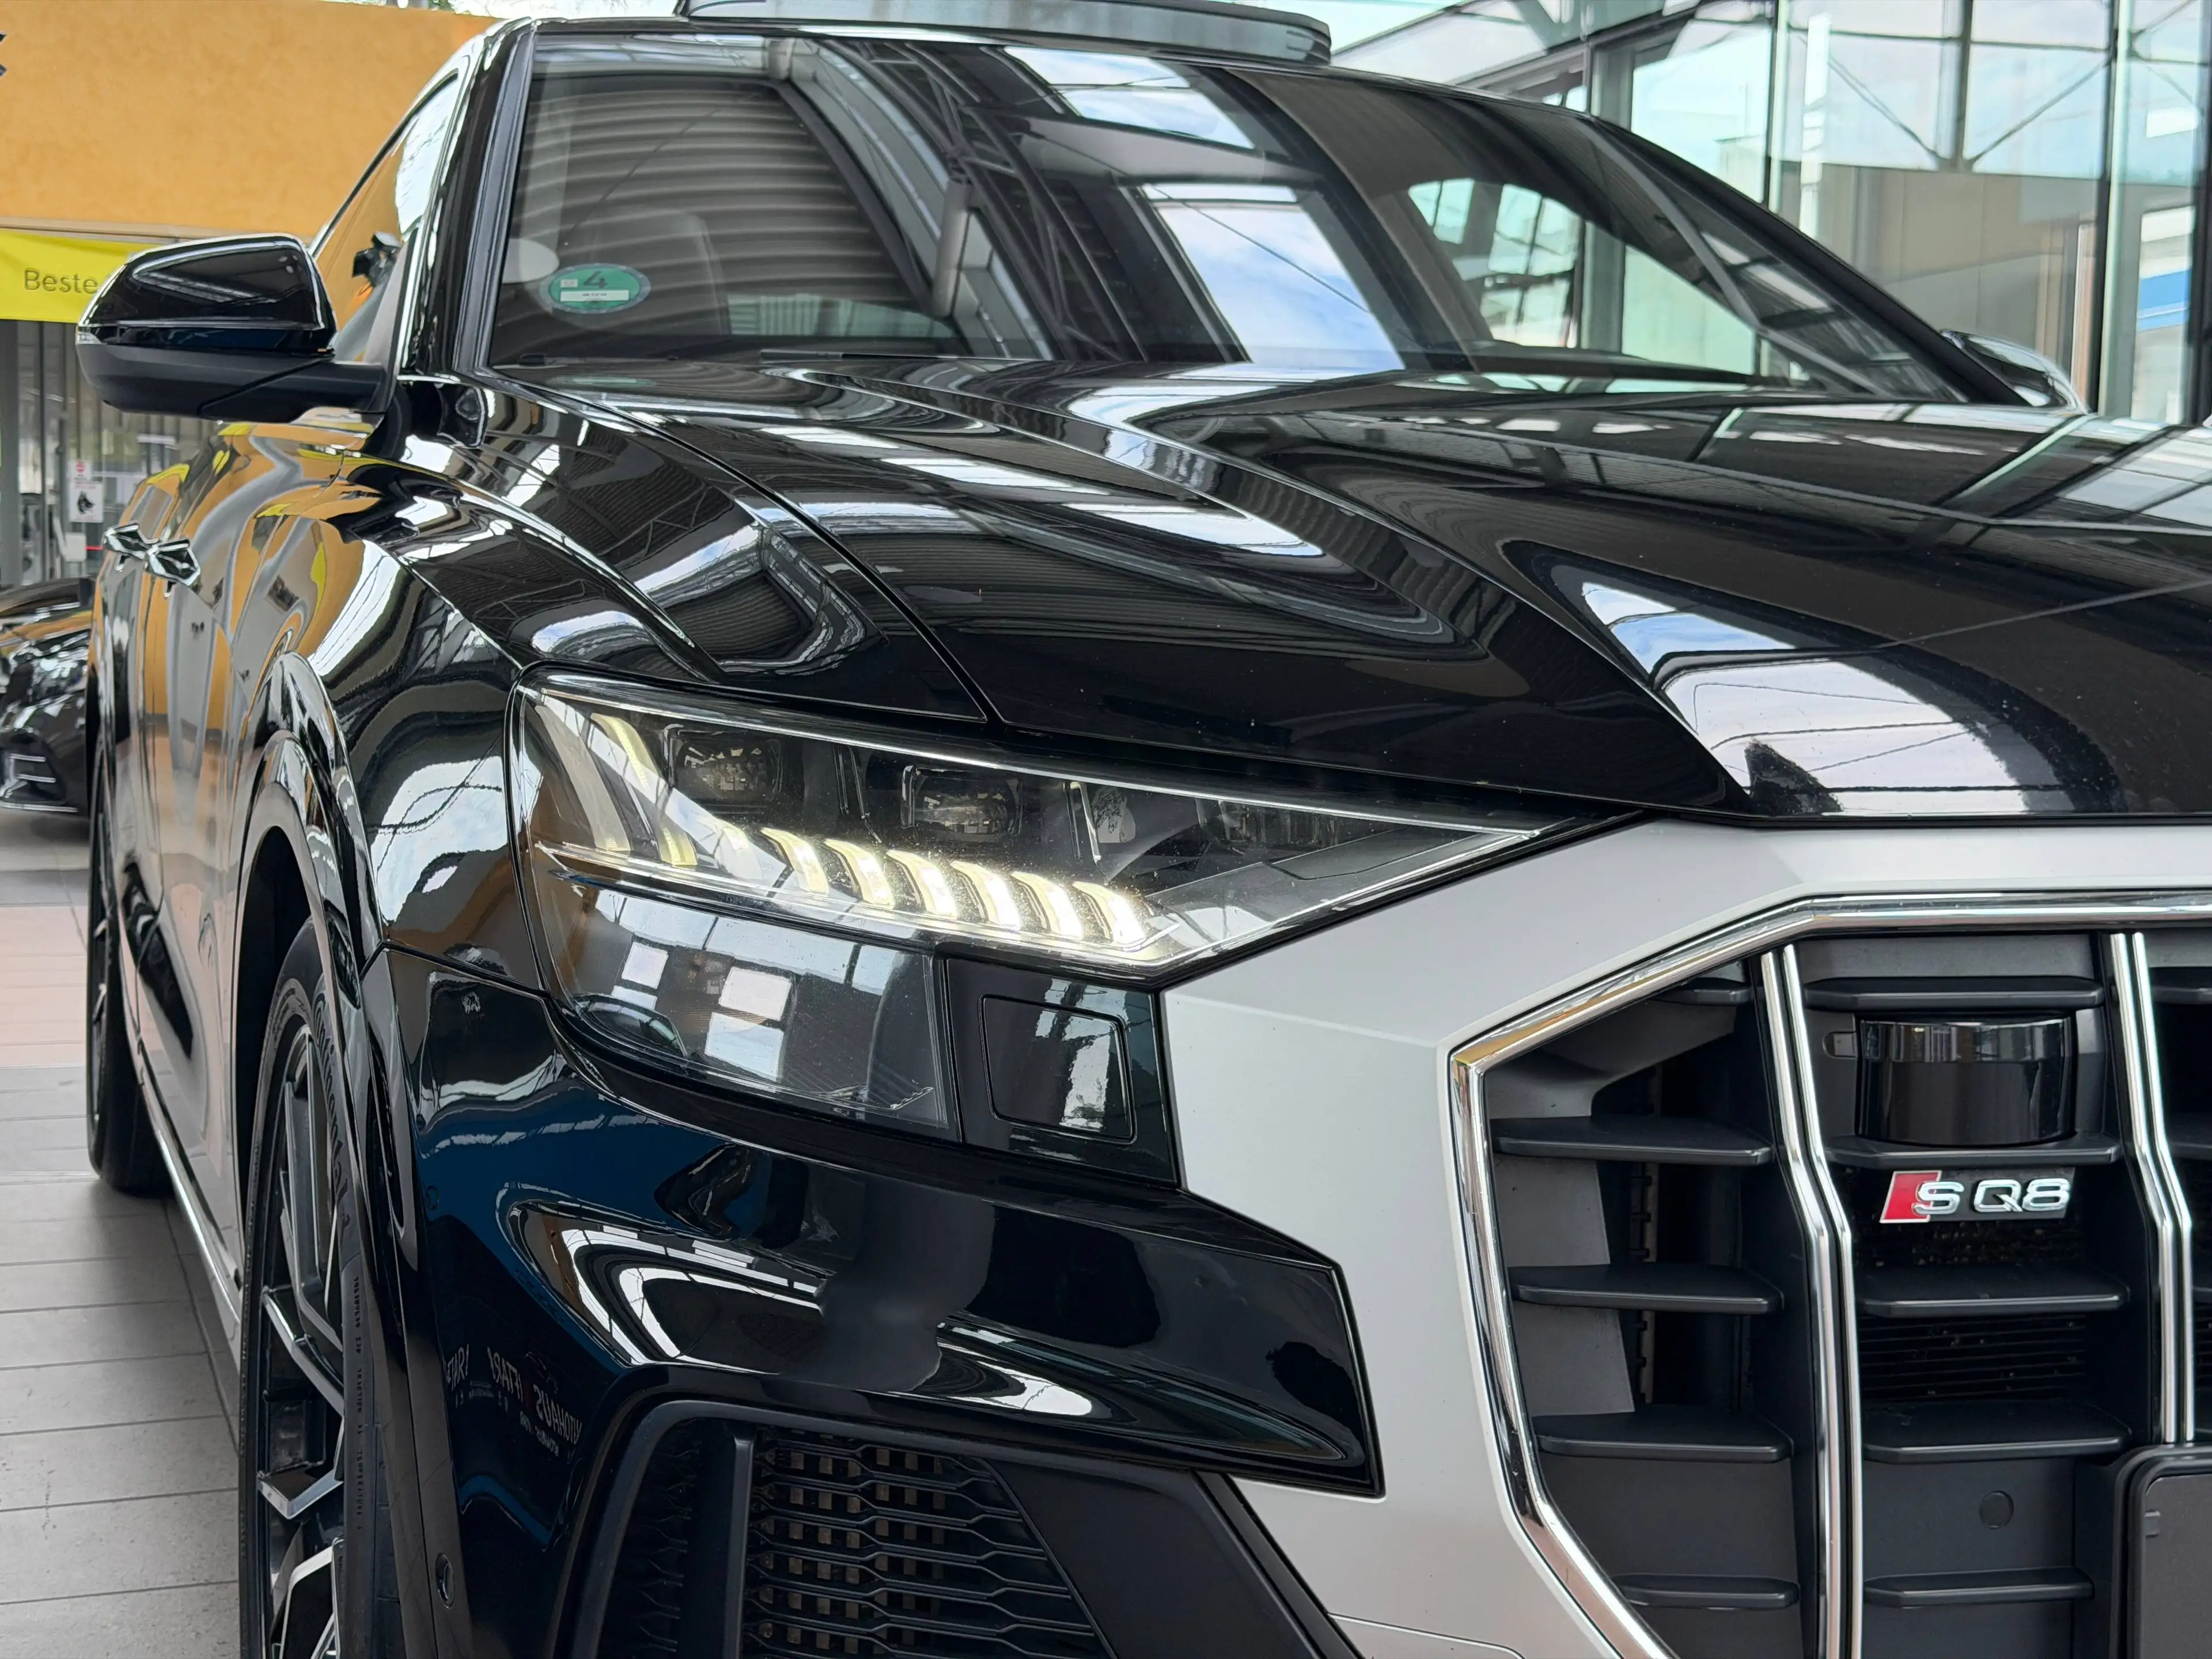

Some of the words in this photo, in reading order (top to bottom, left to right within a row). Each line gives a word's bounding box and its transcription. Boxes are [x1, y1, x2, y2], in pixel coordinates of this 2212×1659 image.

[24, 268, 98, 294] Beste
[582, 270, 608, 289] 4
[314, 992, 349, 1206] Continental
